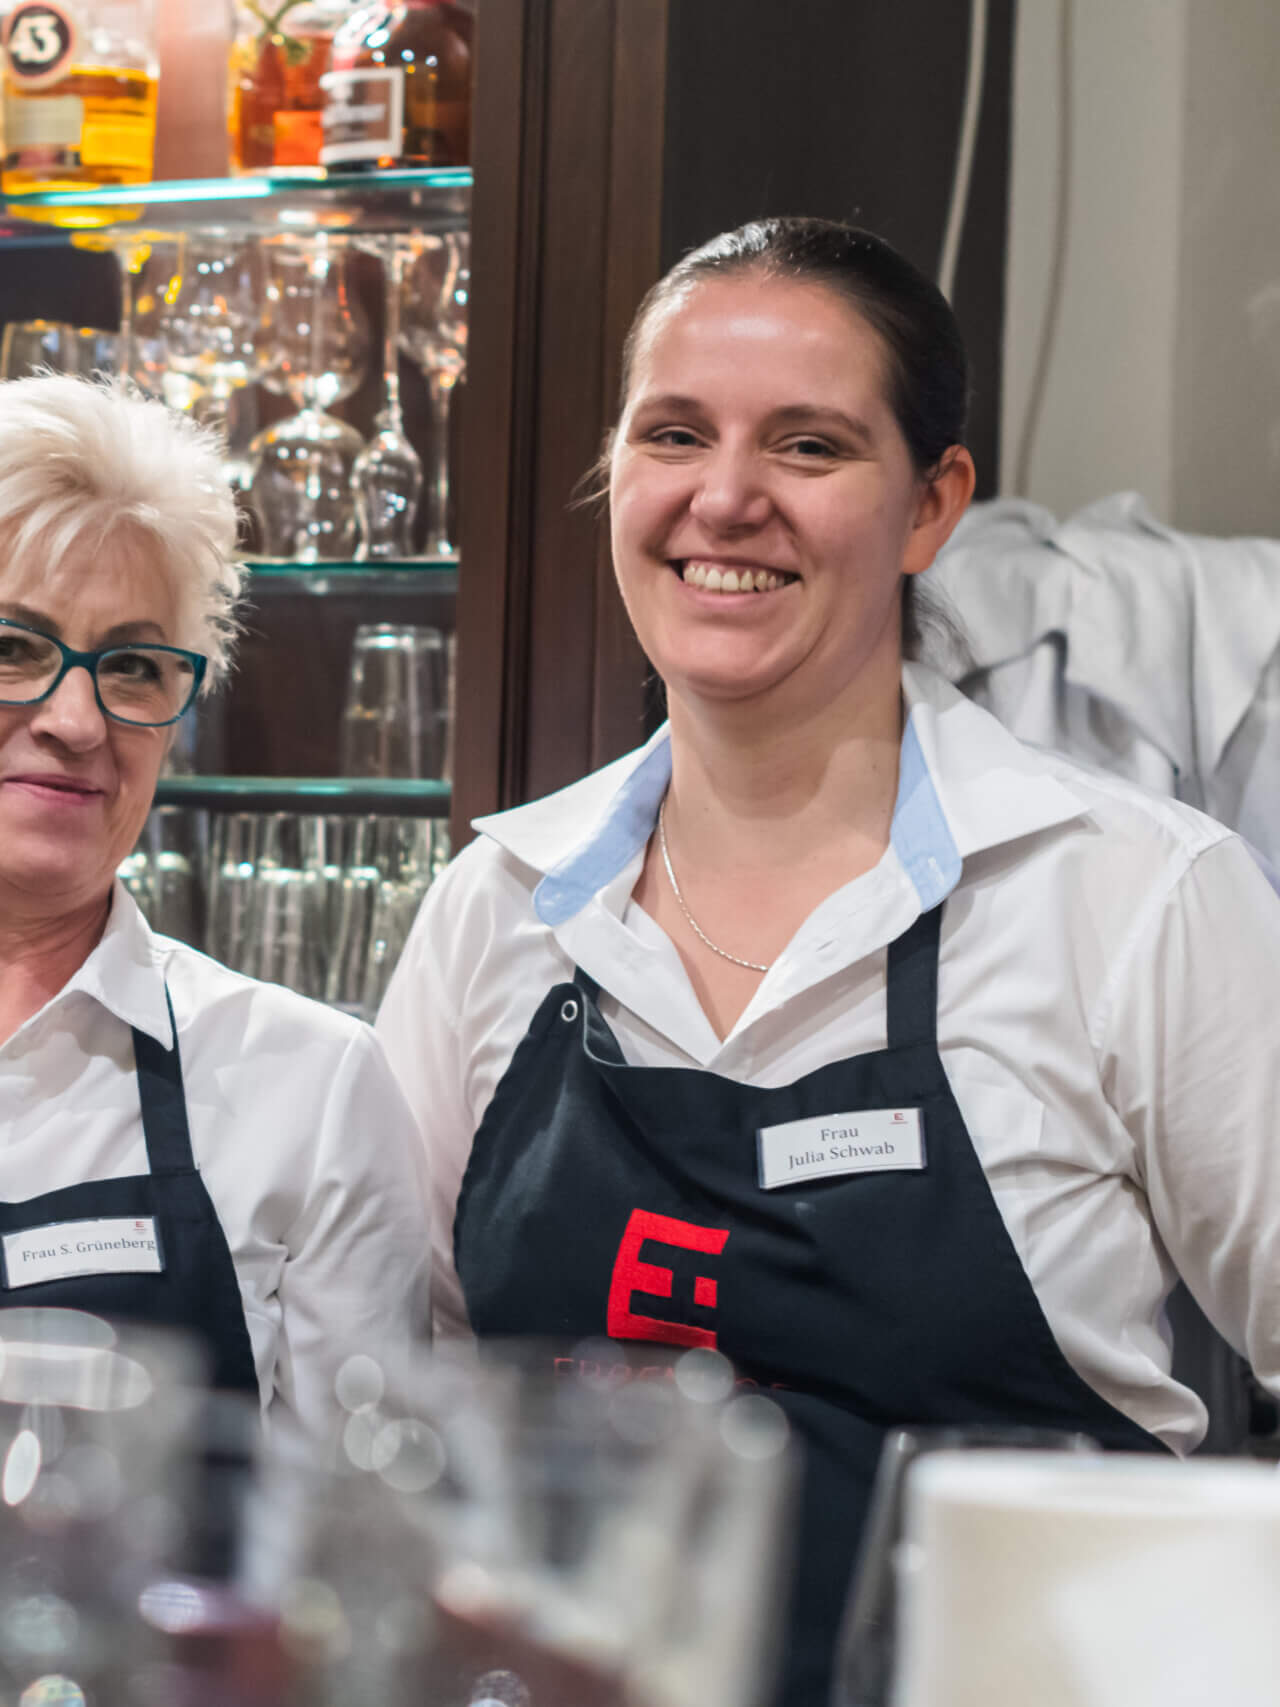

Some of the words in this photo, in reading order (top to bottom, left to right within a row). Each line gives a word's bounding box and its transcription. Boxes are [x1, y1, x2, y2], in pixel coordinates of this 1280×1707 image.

[820, 1127, 859, 1142] Frau
[788, 1151, 825, 1170] Julia
[830, 1142, 895, 1160] Schwab
[22, 1248, 56, 1262] Frau
[60, 1244, 73, 1255] S.
[76, 1238, 156, 1254] Grüneberg
